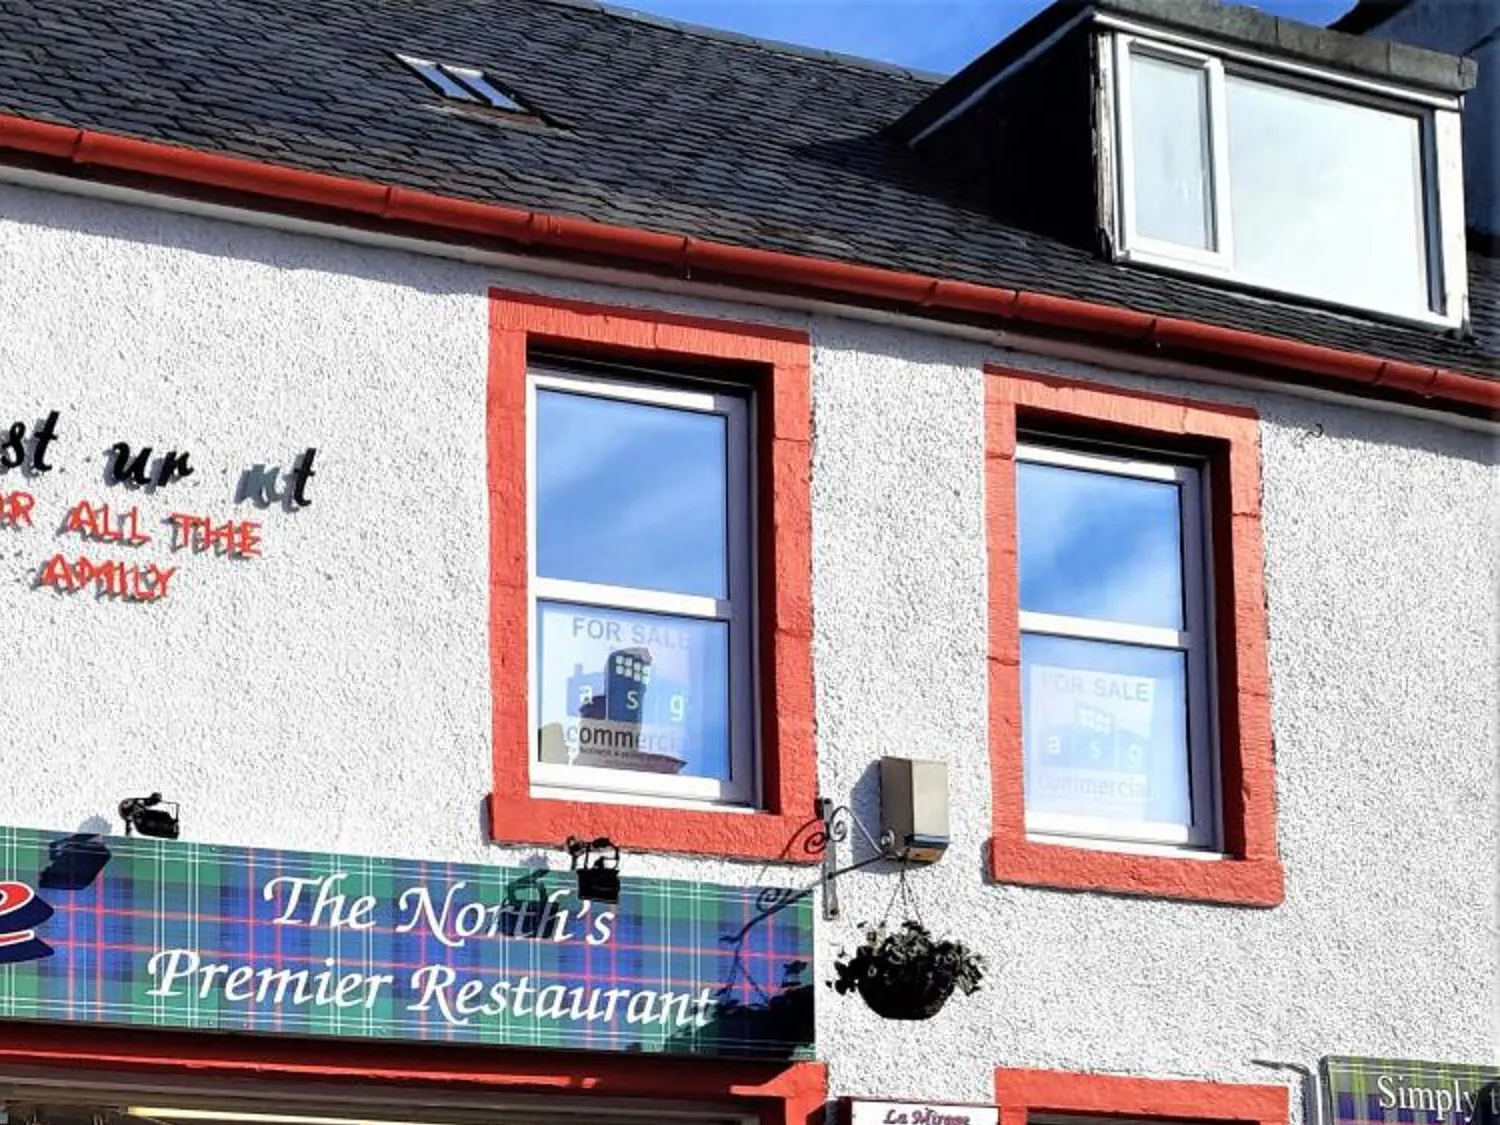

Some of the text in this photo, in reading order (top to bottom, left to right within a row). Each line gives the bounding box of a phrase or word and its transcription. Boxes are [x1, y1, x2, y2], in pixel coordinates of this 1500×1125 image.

[65, 500, 151, 543] ALL
[168, 512, 262, 557] THE
[572, 616, 690, 650] FOR SALE
[1042, 672, 1151, 702] FOR SALE
[263, 874, 615, 948] The North's
[145, 949, 718, 1027] Premier Restaurant
[883, 1108, 908, 1124] La
[1376, 1074, 1477, 1122] Simply
